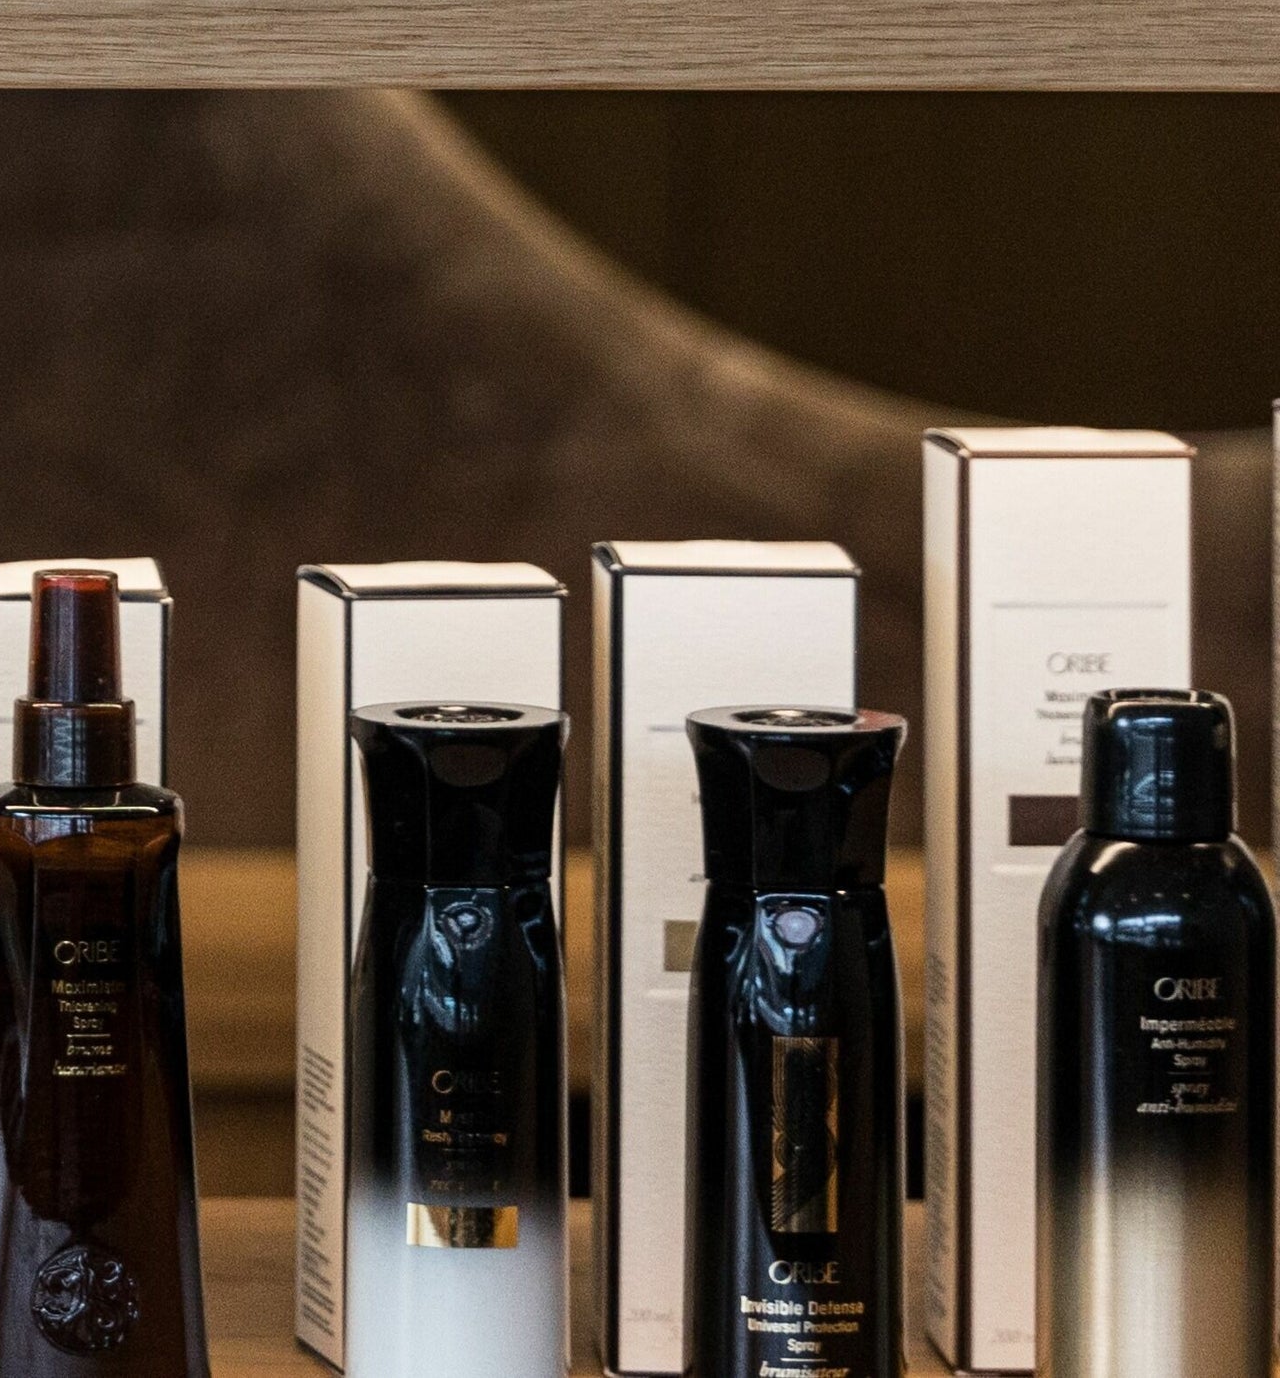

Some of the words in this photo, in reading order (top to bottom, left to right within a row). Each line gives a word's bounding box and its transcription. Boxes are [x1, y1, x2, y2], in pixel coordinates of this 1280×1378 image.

[54, 940, 122, 964] ORIBE
[1154, 976, 1223, 1001] ORIBE
[1173, 1053, 1207, 1067] Spray
[740, 1295, 804, 1316] Invisible
[806, 1300, 865, 1316] Defense
[747, 1317, 802, 1334] Universal
[803, 1320, 859, 1334] Protection
[786, 1338, 822, 1354] Spray
